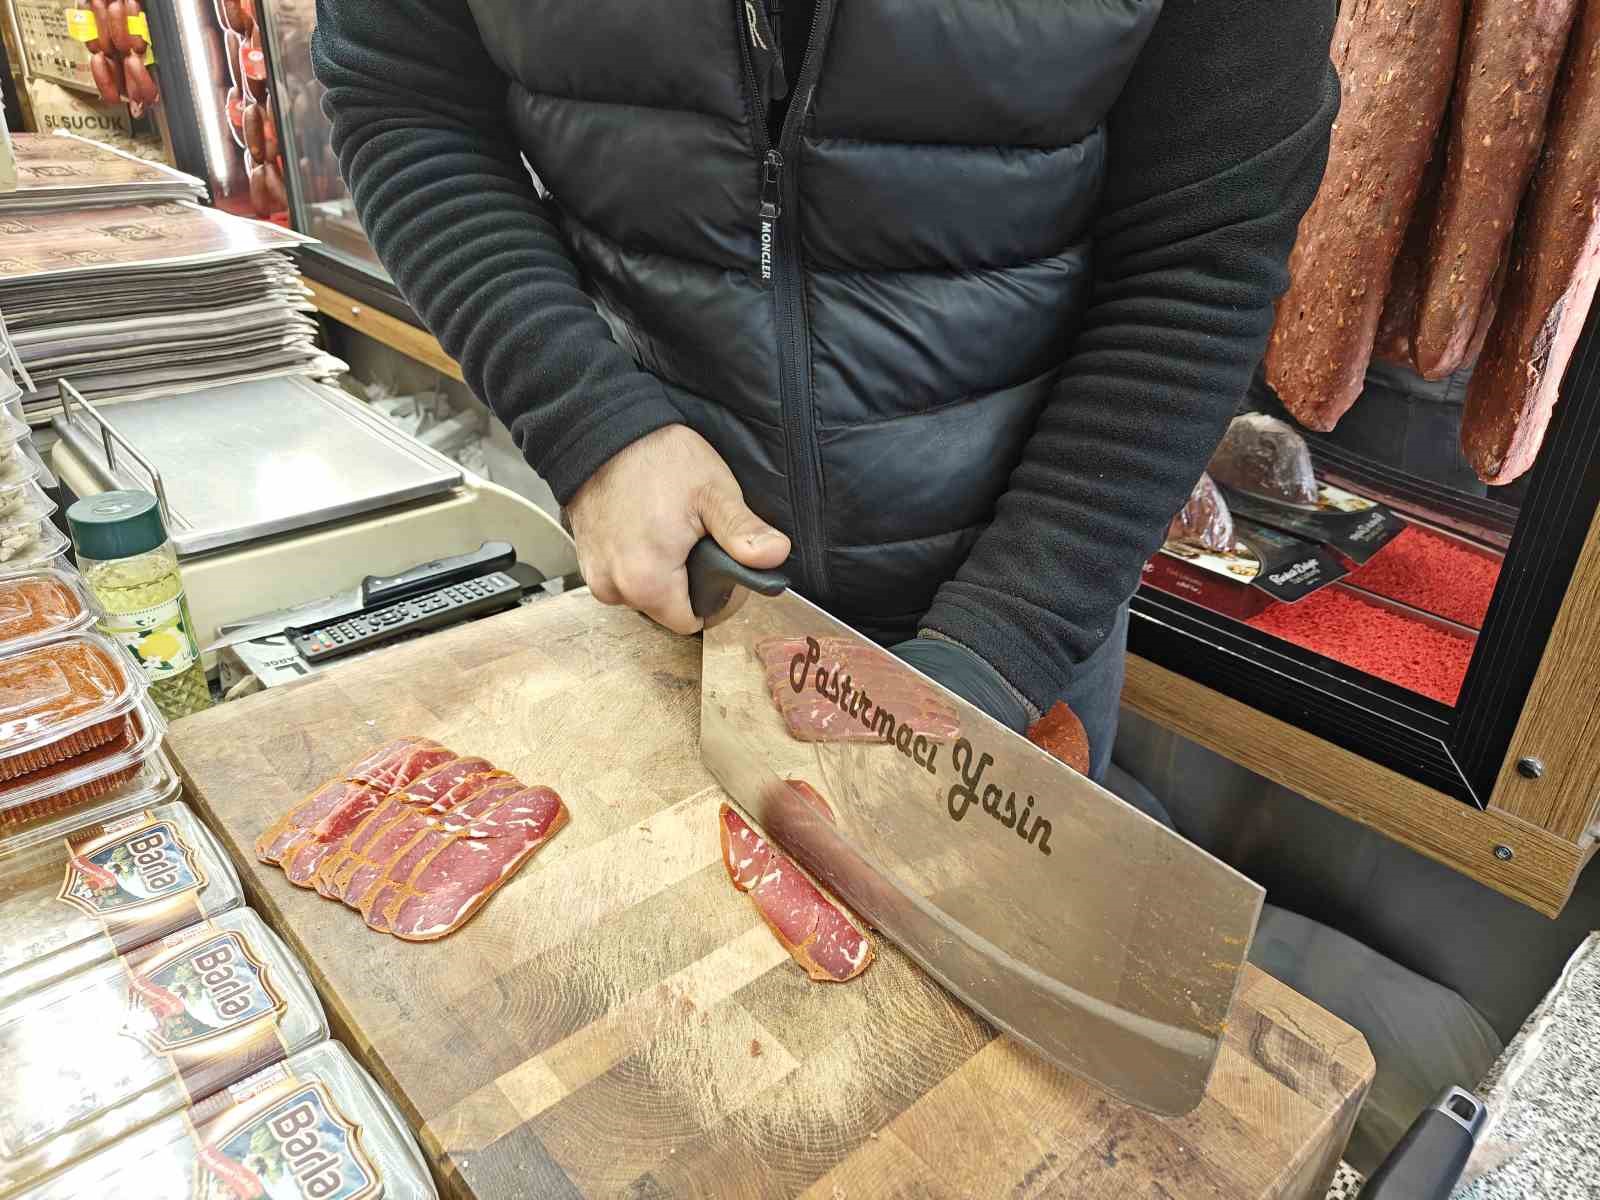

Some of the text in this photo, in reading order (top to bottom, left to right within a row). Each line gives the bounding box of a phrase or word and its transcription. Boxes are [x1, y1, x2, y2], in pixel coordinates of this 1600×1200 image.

[61, 115, 123, 130] SUCUK
[760, 221, 772, 280] MONCLER
[947, 737, 1053, 857] Yasin
[129, 833, 178, 891] Barla
[194, 946, 251, 1017] Barla
[271, 1103, 342, 1199] Barla
